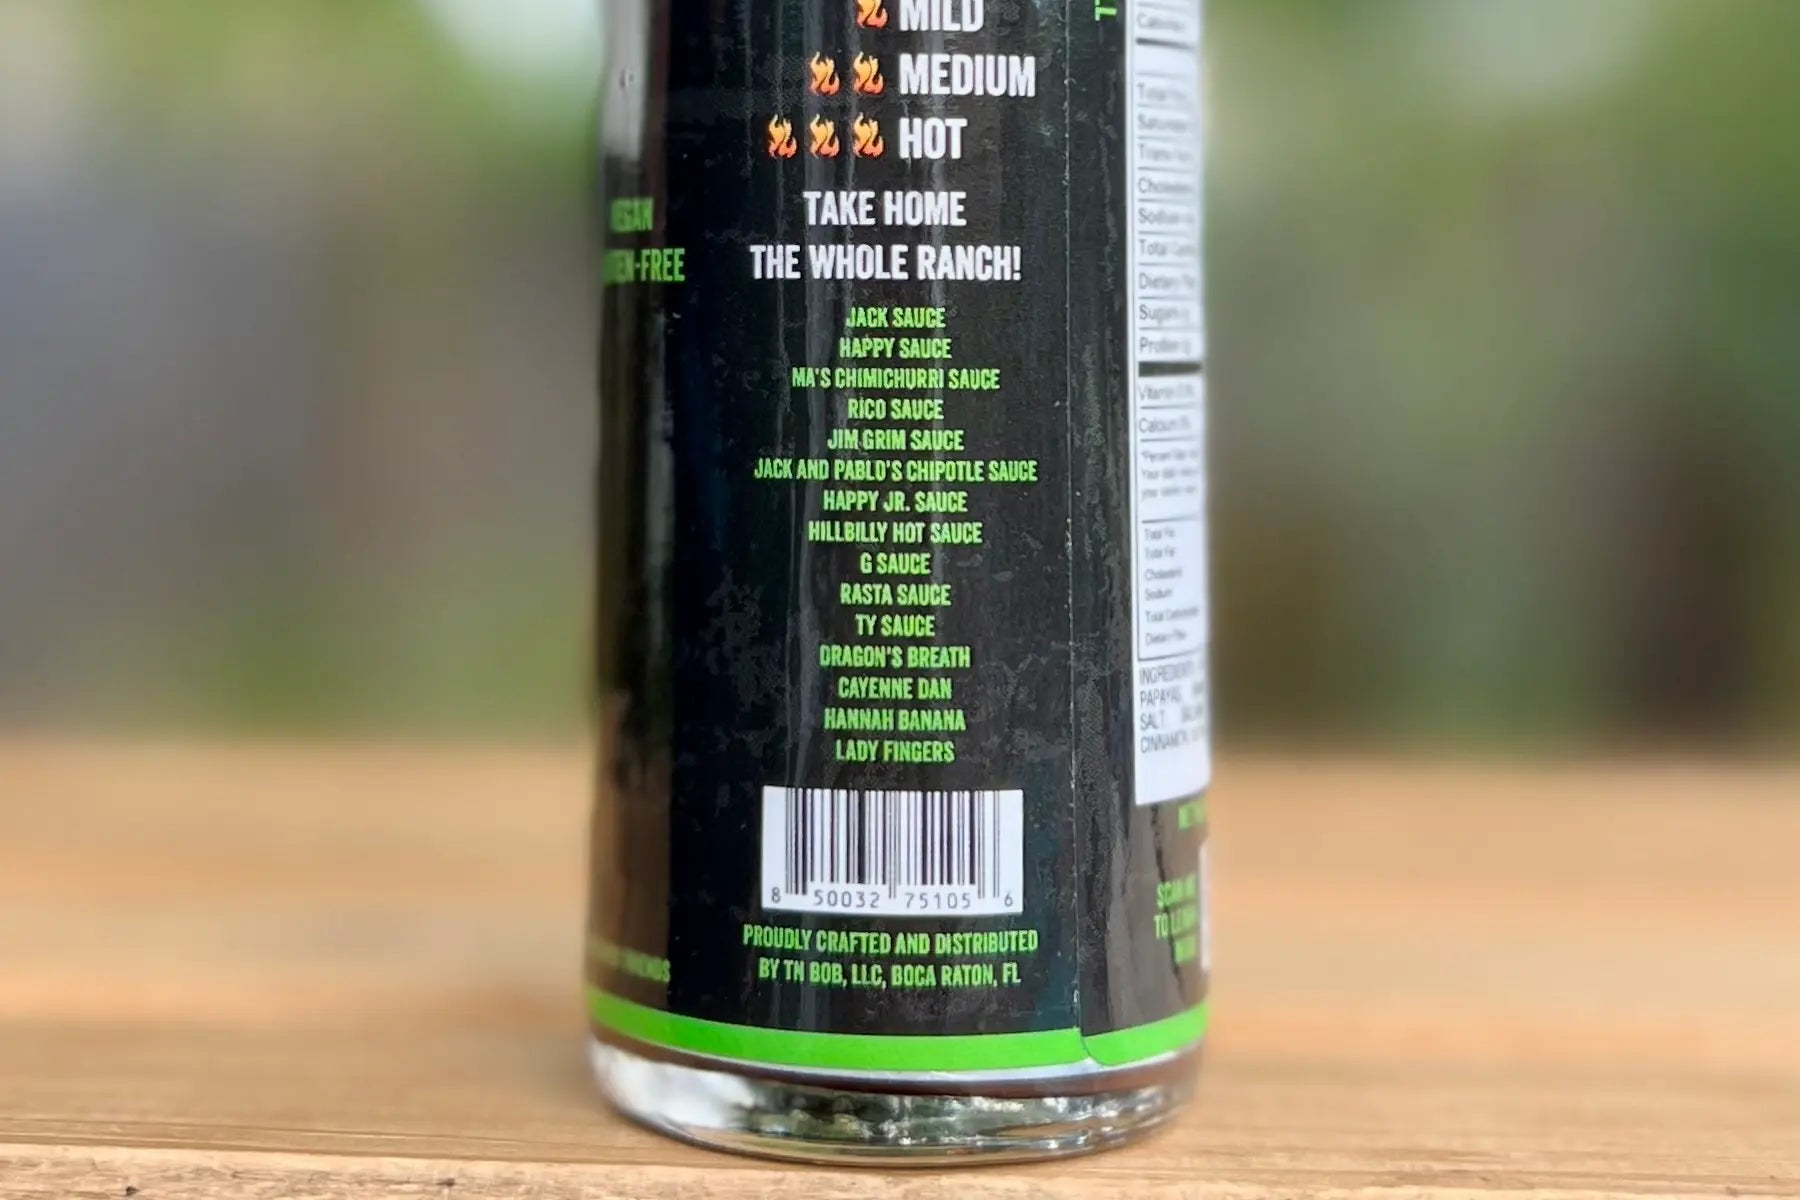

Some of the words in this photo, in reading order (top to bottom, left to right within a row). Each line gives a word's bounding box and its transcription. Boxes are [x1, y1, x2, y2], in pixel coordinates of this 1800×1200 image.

[898, 51, 1036, 98] MEDIUM
[898, 116, 968, 160] HOT
[802, 190, 876, 226] TAKE
[883, 190, 967, 227] HOME
[749, 244, 801, 279] THE
[807, 243, 909, 280] WHOLE
[916, 244, 1021, 282] RANCH!
[845, 306, 889, 329] JACK
[891, 306, 946, 329] SAUCE
[839, 337, 895, 359] HAPPY
[898, 337, 951, 360] SAUCE
[791, 366, 832, 389] MA'S
[834, 367, 945, 390] CHIMICHURRI
[947, 368, 1000, 391] SAUCE
[847, 397, 887, 420] RICO
[890, 397, 944, 421] SAUCE
[826, 428, 860, 451] JIM
[860, 428, 907, 451] GRIM
[909, 428, 965, 453] SAUCE
[753, 457, 793, 479] JACK
[795, 458, 830, 481] AND
[833, 458, 903, 482] PABLO'S
[905, 459, 985, 483] CHIPOTLE
[987, 459, 1038, 482] SAUCE
[822, 489, 879, 511] HAPPY
[883, 490, 911, 513] JR.
[914, 490, 967, 513] SAUCE
[807, 520, 889, 543] HILLBILLY
[892, 522, 924, 544] HOT
[929, 521, 983, 545] SAUCE
[859, 551, 873, 574] G
[876, 552, 929, 575] SAUCE
[839, 582, 894, 606] RASTA
[896, 583, 951, 607] SAUCE
[856, 613, 877, 636] TY
[880, 614, 935, 638] SAUCE
[819, 644, 904, 669] DRAGON'S
[906, 645, 971, 669] BREATH
[838, 676, 914, 700] CAYENNE
[917, 678, 953, 700] DAN
[823, 707, 895, 732] HANNAH
[897, 709, 967, 732] BANANA
[835, 739, 879, 762] LADY
[882, 739, 955, 764] FINGERS
[771, 887, 782, 904] 8
[814, 889, 881, 909] 50032
[904, 892, 972, 910] 75105
[1003, 894, 1015, 908] 6
[743, 925, 813, 951] PROUDLY
[815, 929, 892, 955] CRAFTED
[894, 933, 931, 955] AND
[934, 929, 1039, 956] DISTRIBUTED
[759, 957, 781, 980] BY
[783, 959, 805, 983] TN
[809, 960, 848, 988] BOB,
[851, 962, 887, 989] LLC,
[890, 964, 937, 988] BOCA
[940, 962, 997, 989] RATON,
[1002, 961, 1021, 984] FL
